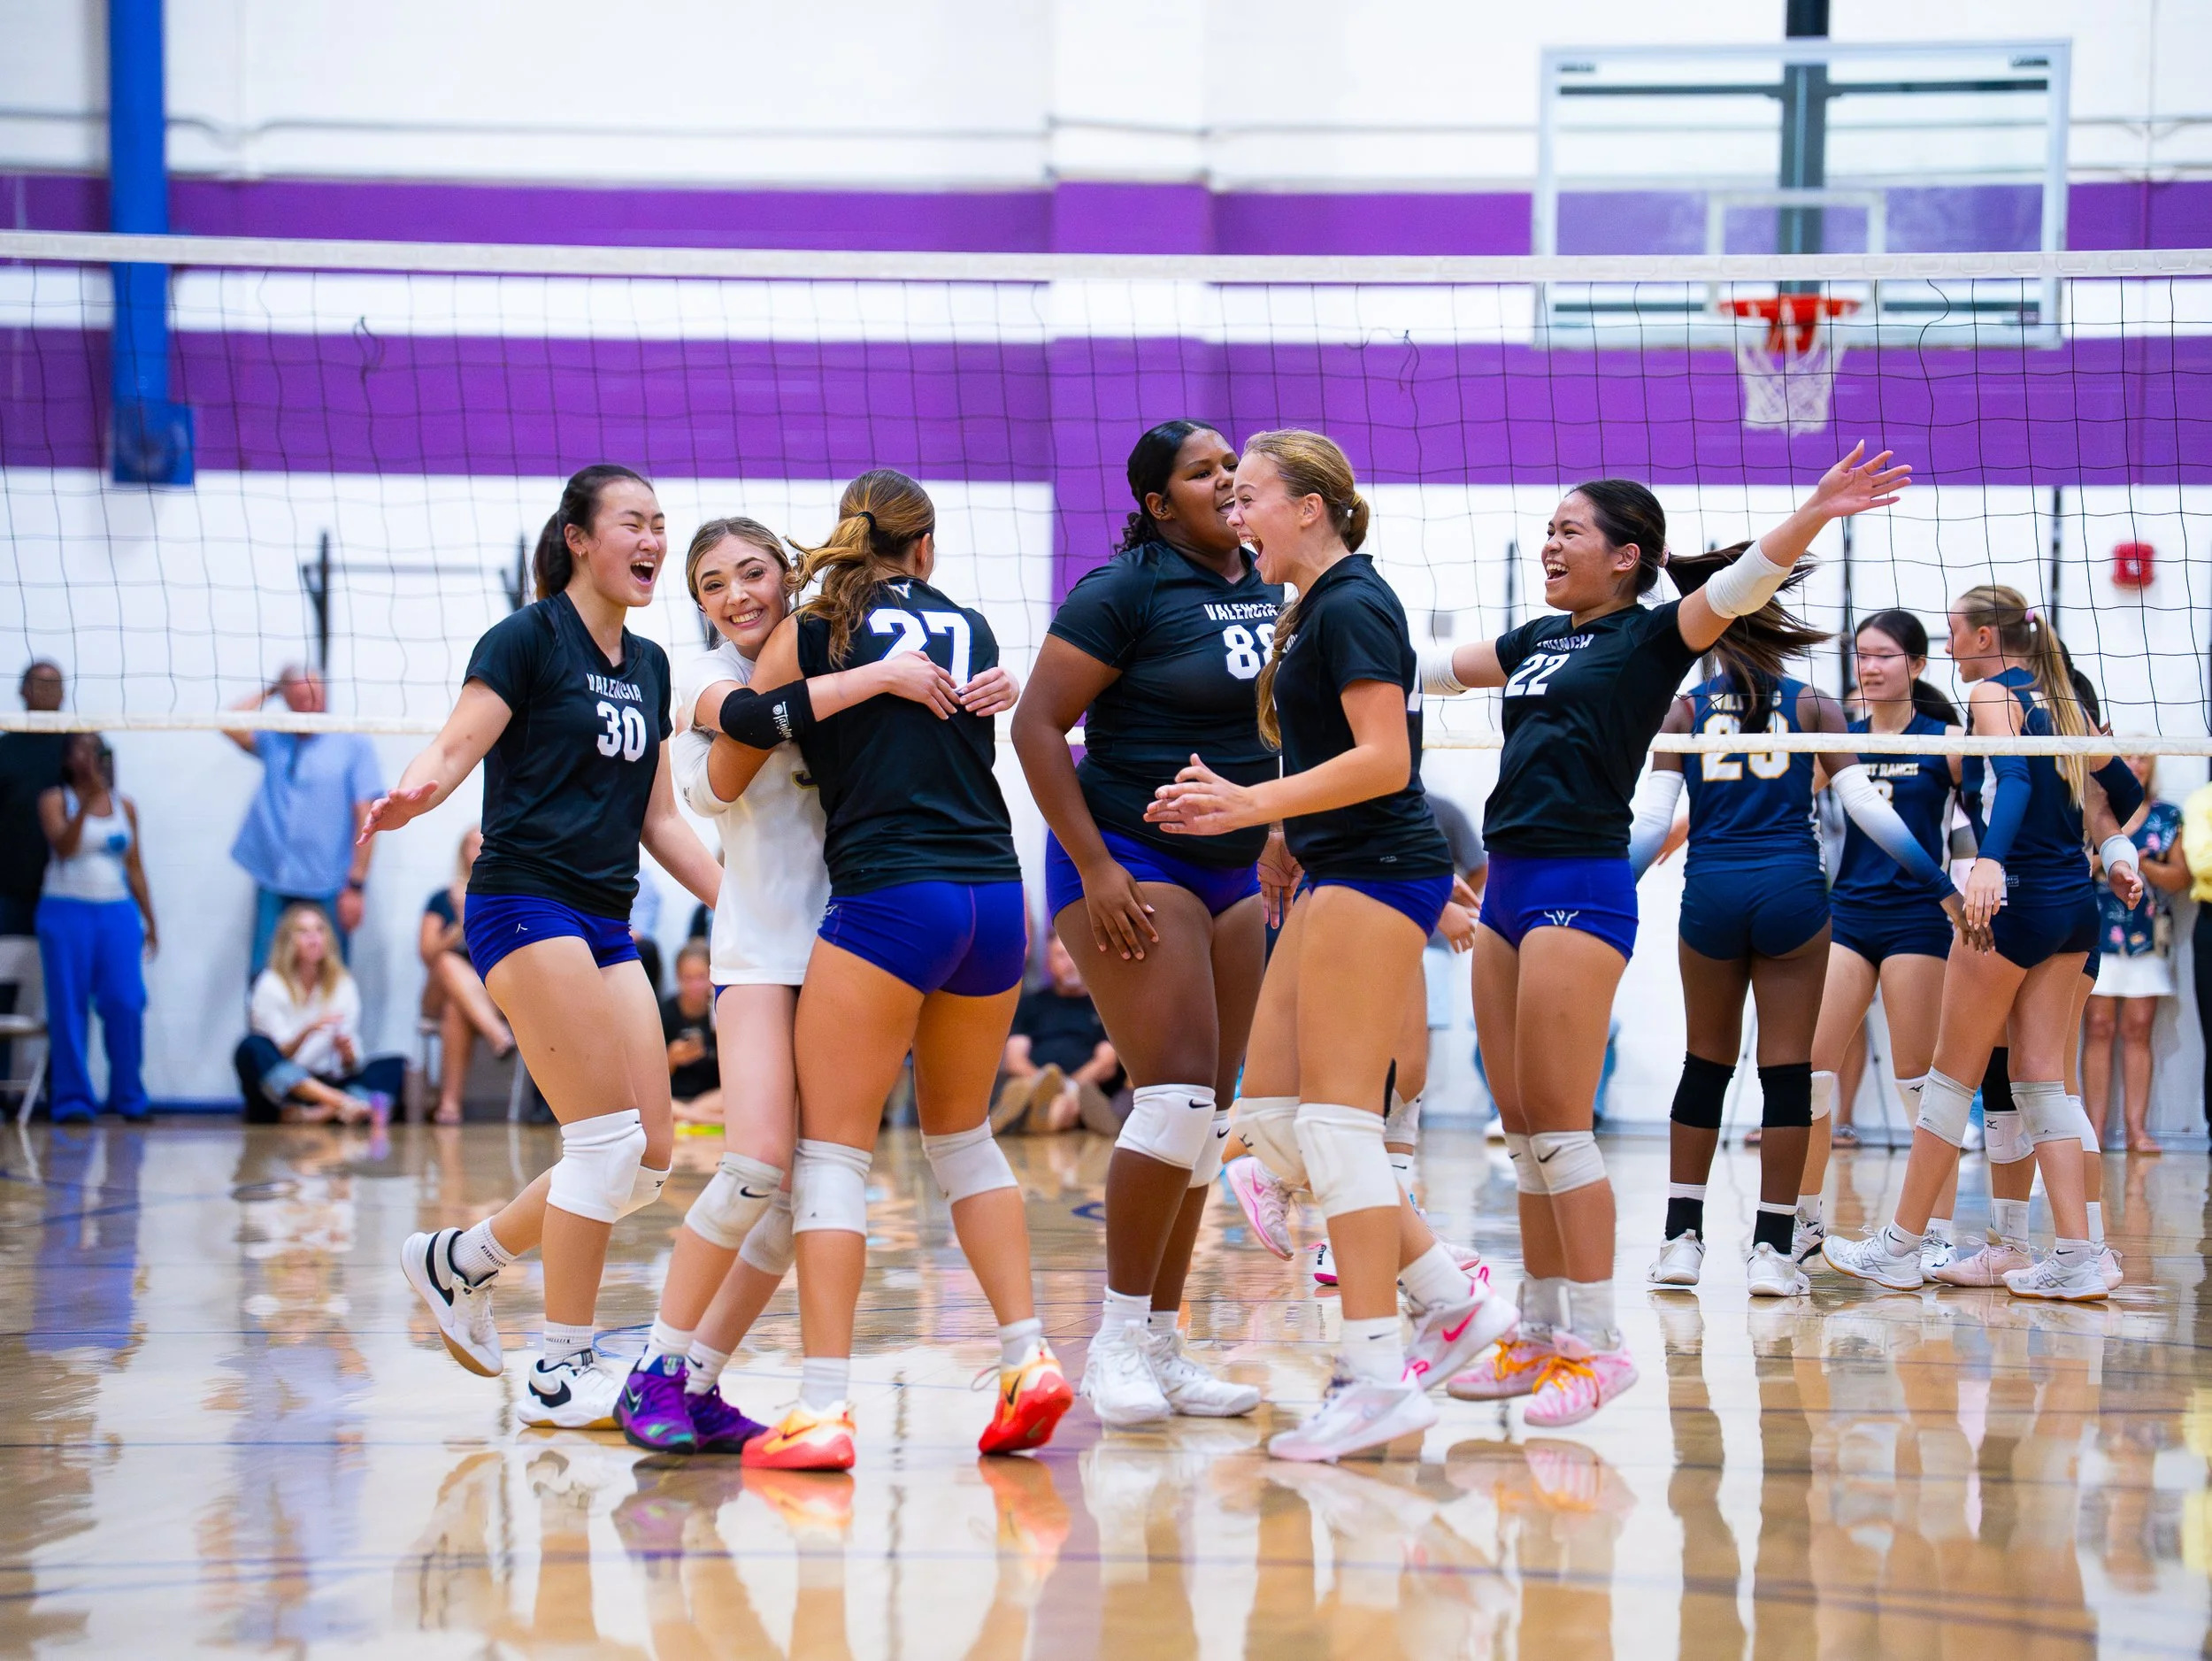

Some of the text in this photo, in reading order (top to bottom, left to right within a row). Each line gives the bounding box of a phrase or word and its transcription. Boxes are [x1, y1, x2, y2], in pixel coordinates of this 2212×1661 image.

[1203, 604, 1279, 620] VALENCIA
[865, 606, 972, 692] 27
[586, 673, 643, 703] VALENCIA
[1504, 653, 1571, 697] 22
[596, 700, 647, 762] 30
